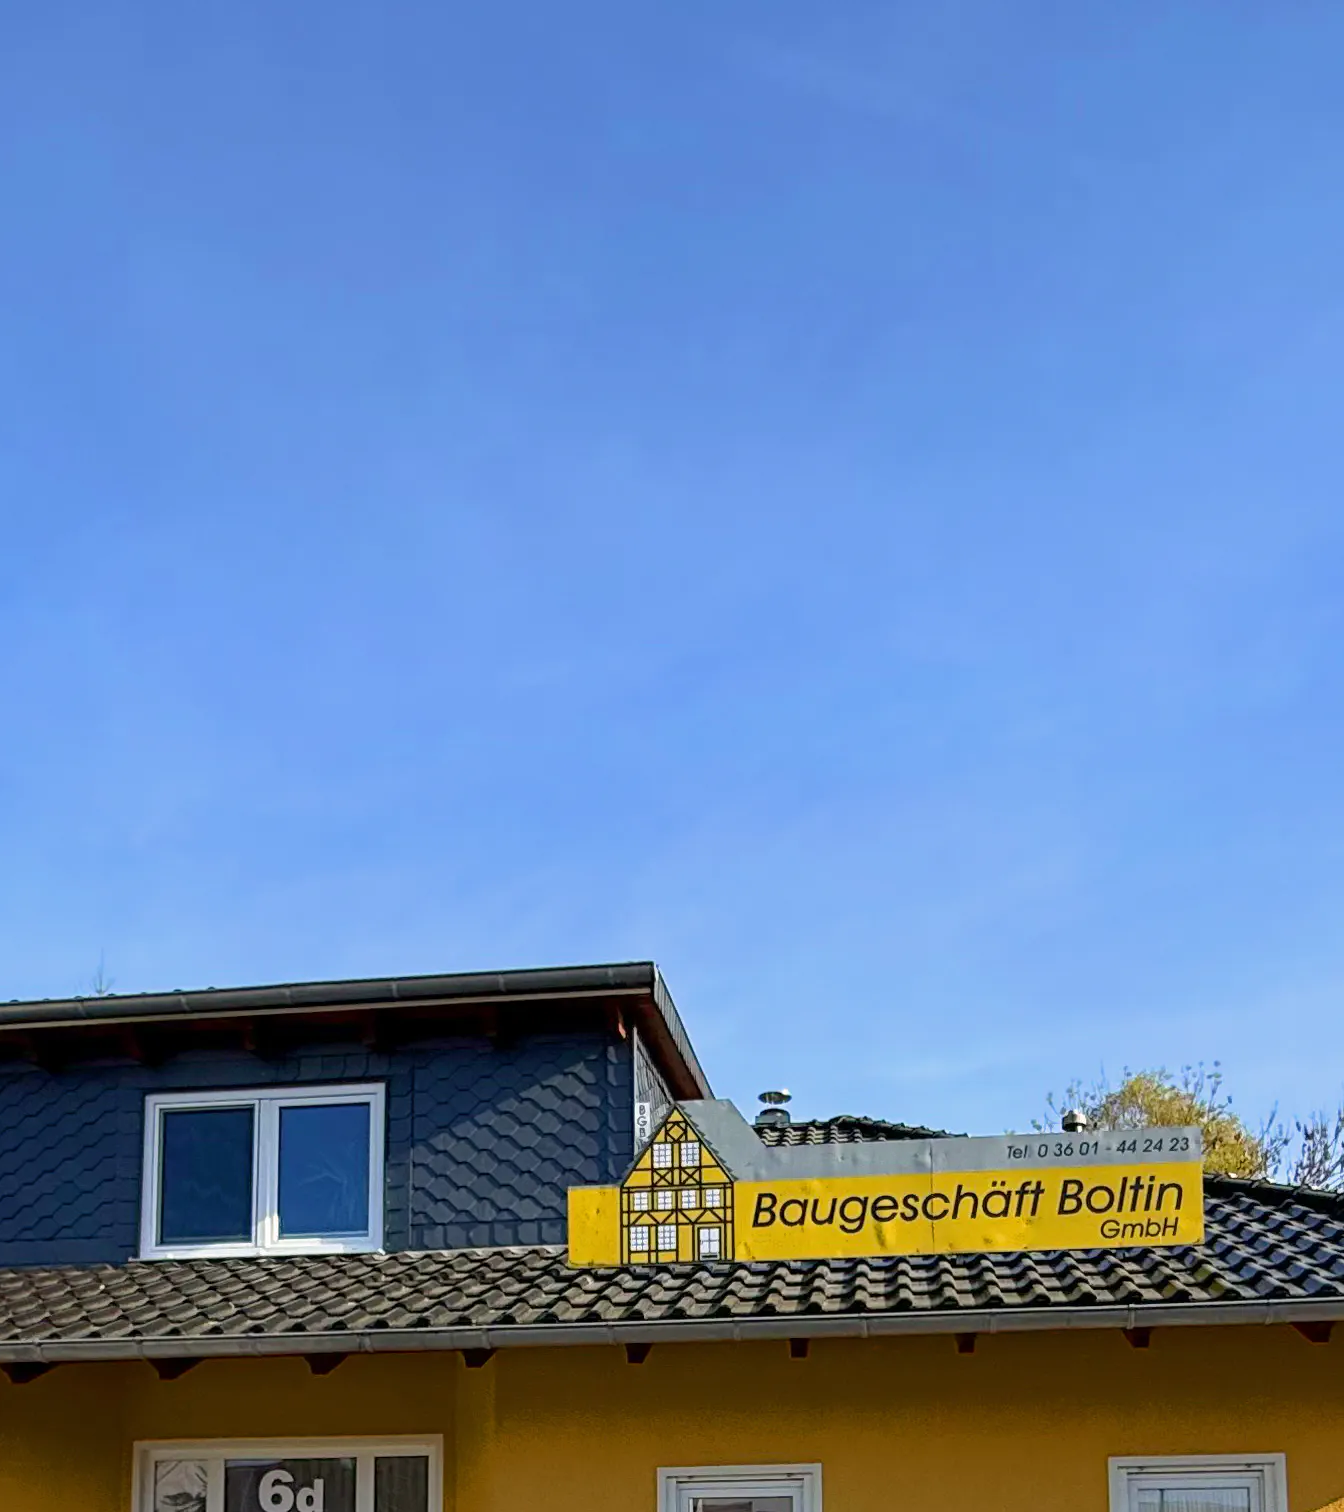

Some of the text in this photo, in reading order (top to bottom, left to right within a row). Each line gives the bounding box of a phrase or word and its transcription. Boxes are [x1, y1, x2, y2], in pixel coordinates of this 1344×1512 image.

[1037, 1143, 1049, 1158] 0
[1053, 1142, 1074, 1157] 36
[1079, 1140, 1099, 1156] 01
[1116, 1139, 1137, 1154] 44
[1142, 1137, 1164, 1153] 24
[1168, 1136, 1190, 1152] 23
[752, 1175, 1183, 1234] Baugeschäft Boltin
[1100, 1216, 1179, 1239] GmbH
